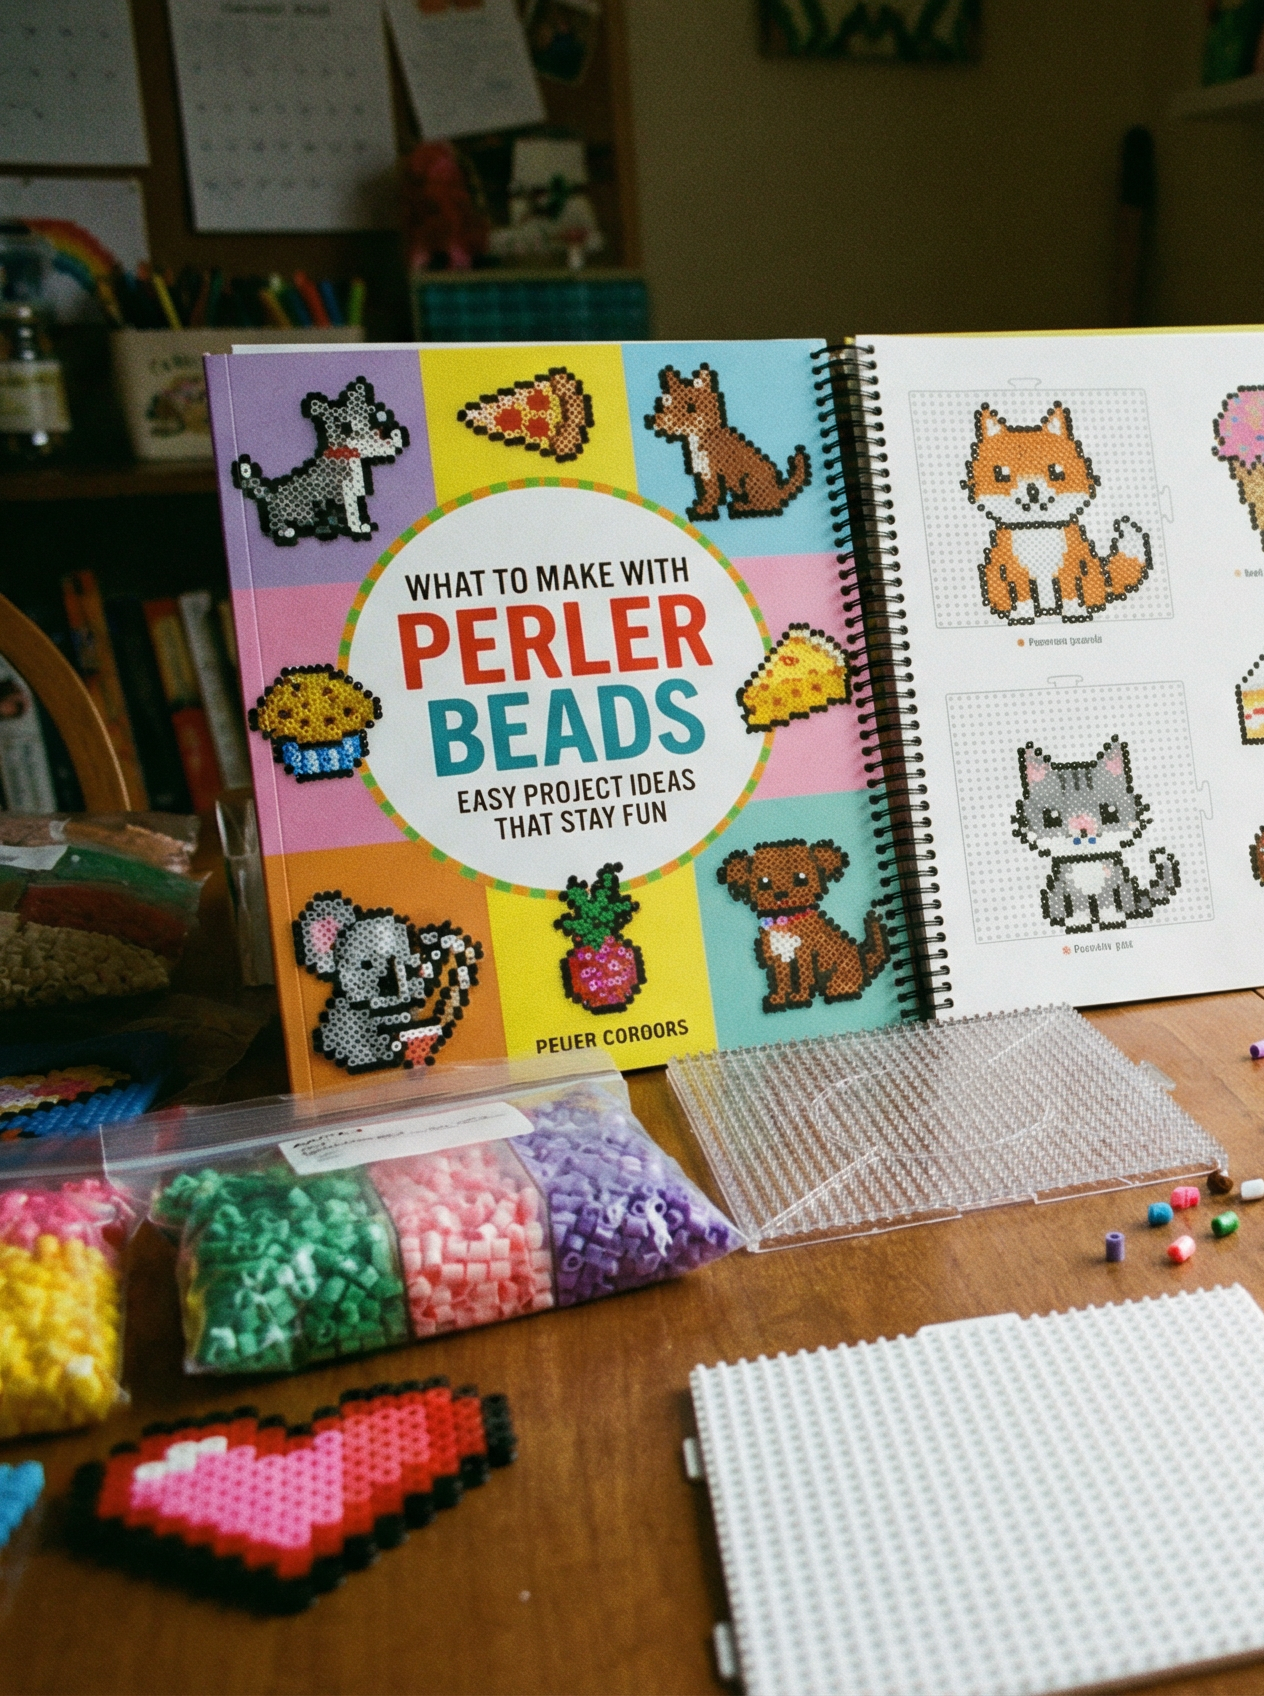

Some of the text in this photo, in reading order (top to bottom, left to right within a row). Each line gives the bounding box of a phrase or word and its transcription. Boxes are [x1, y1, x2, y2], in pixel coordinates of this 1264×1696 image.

[405, 556, 690, 601] WHAT TO MAKE WITH
[397, 593, 713, 690] PERLER
[428, 678, 706, 777] BEADS
[457, 768, 697, 814] EASY PROJECT IDEAS
[494, 800, 668, 840] THAT STAY FUN
[536, 1032, 597, 1055] PEUER
